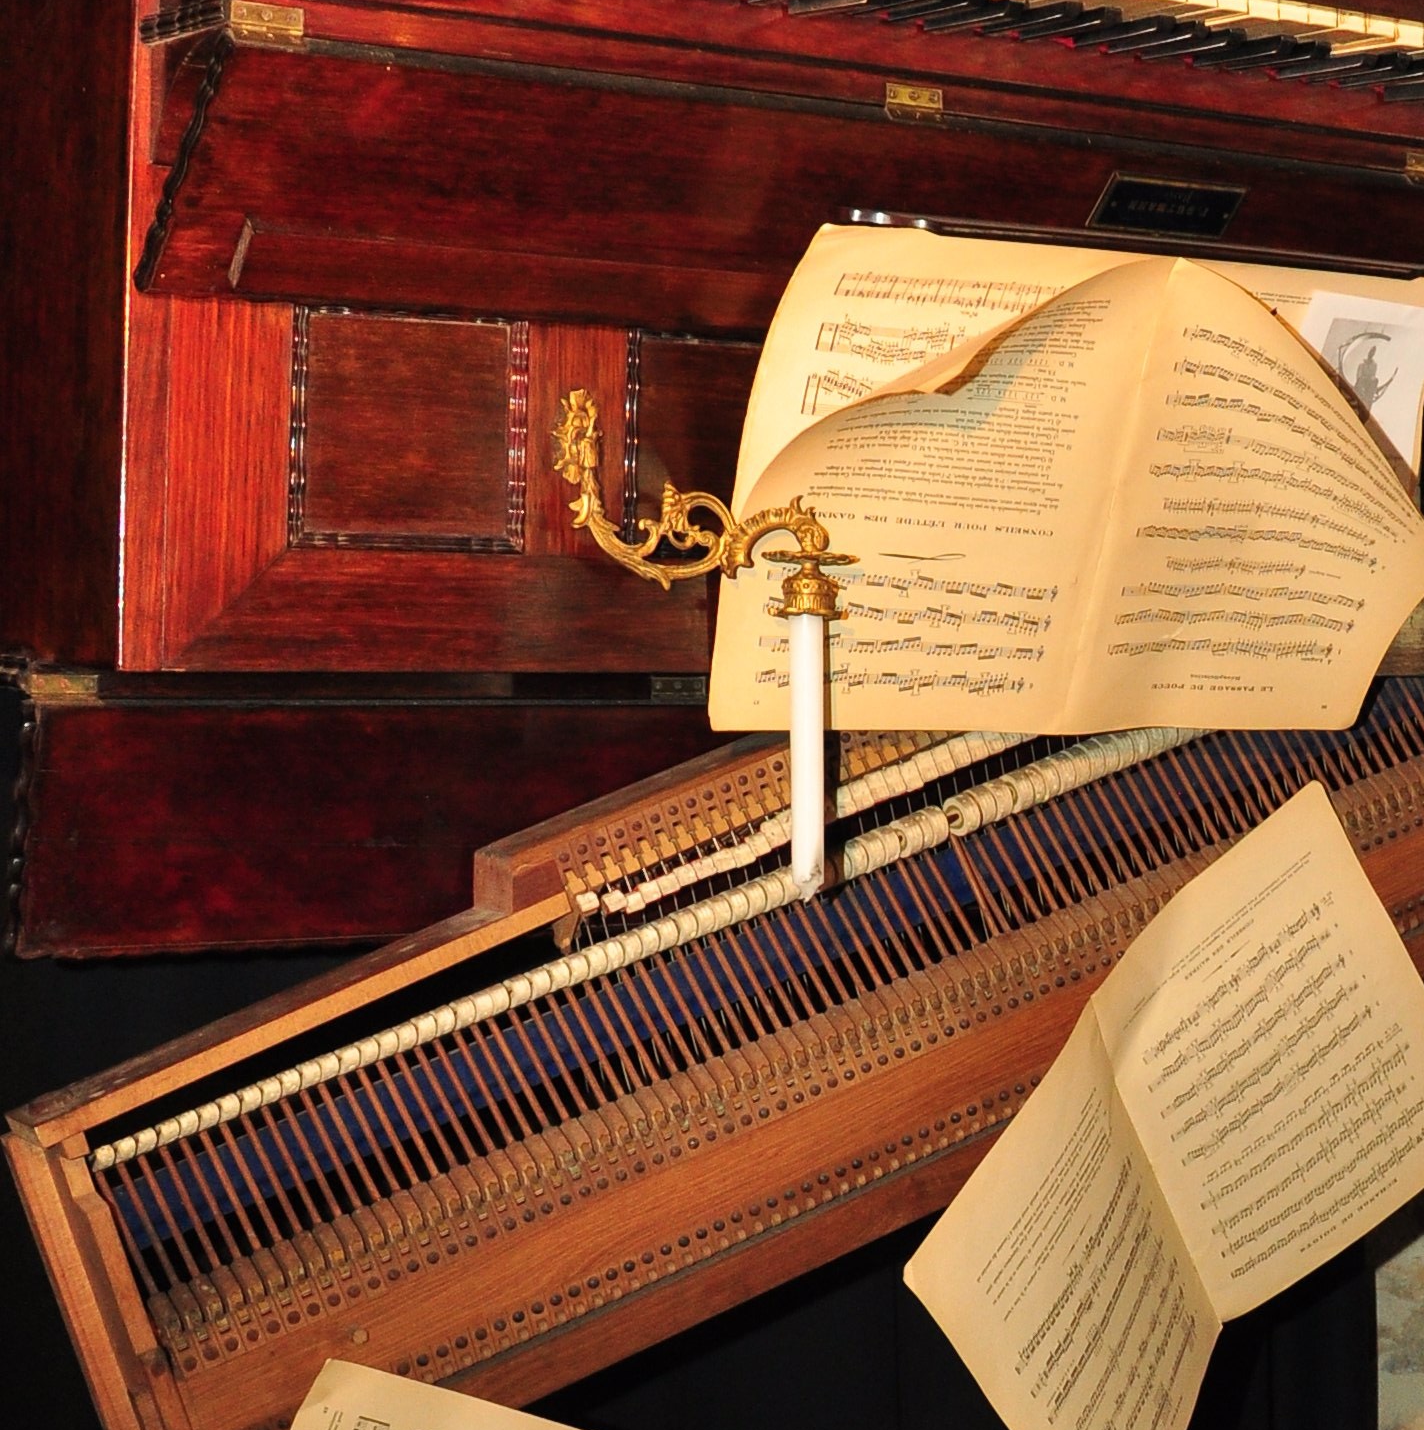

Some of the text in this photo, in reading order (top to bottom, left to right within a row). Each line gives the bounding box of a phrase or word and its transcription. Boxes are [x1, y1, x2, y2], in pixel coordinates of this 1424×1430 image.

[863, 514, 887, 522] DES
[953, 521, 986, 530] POUR
[994, 526, 1053, 536] CONSEILS
